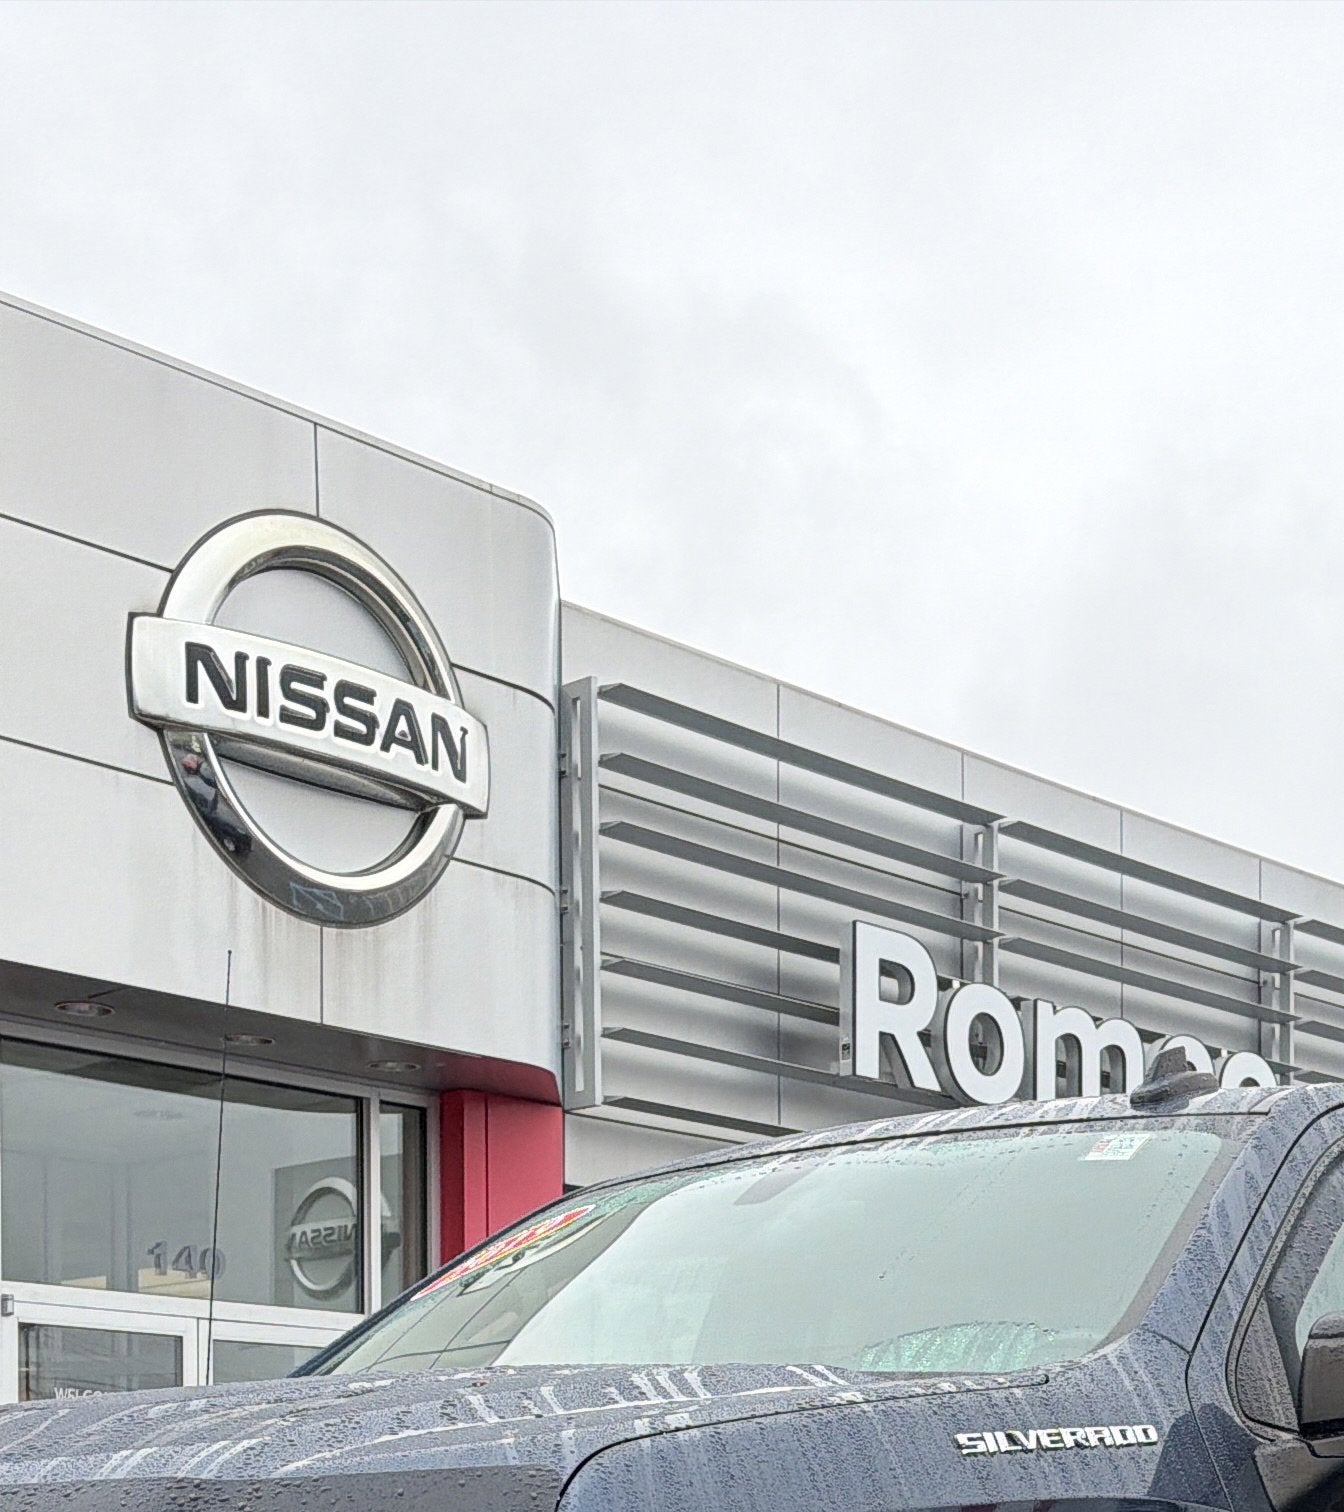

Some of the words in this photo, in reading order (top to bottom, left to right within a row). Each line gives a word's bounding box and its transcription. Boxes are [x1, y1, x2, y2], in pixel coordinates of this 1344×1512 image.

[184, 640, 469, 783] NISSAN
[147, 1240, 226, 1281] 140
[954, 1425, 1158, 1454] SILVERADO
